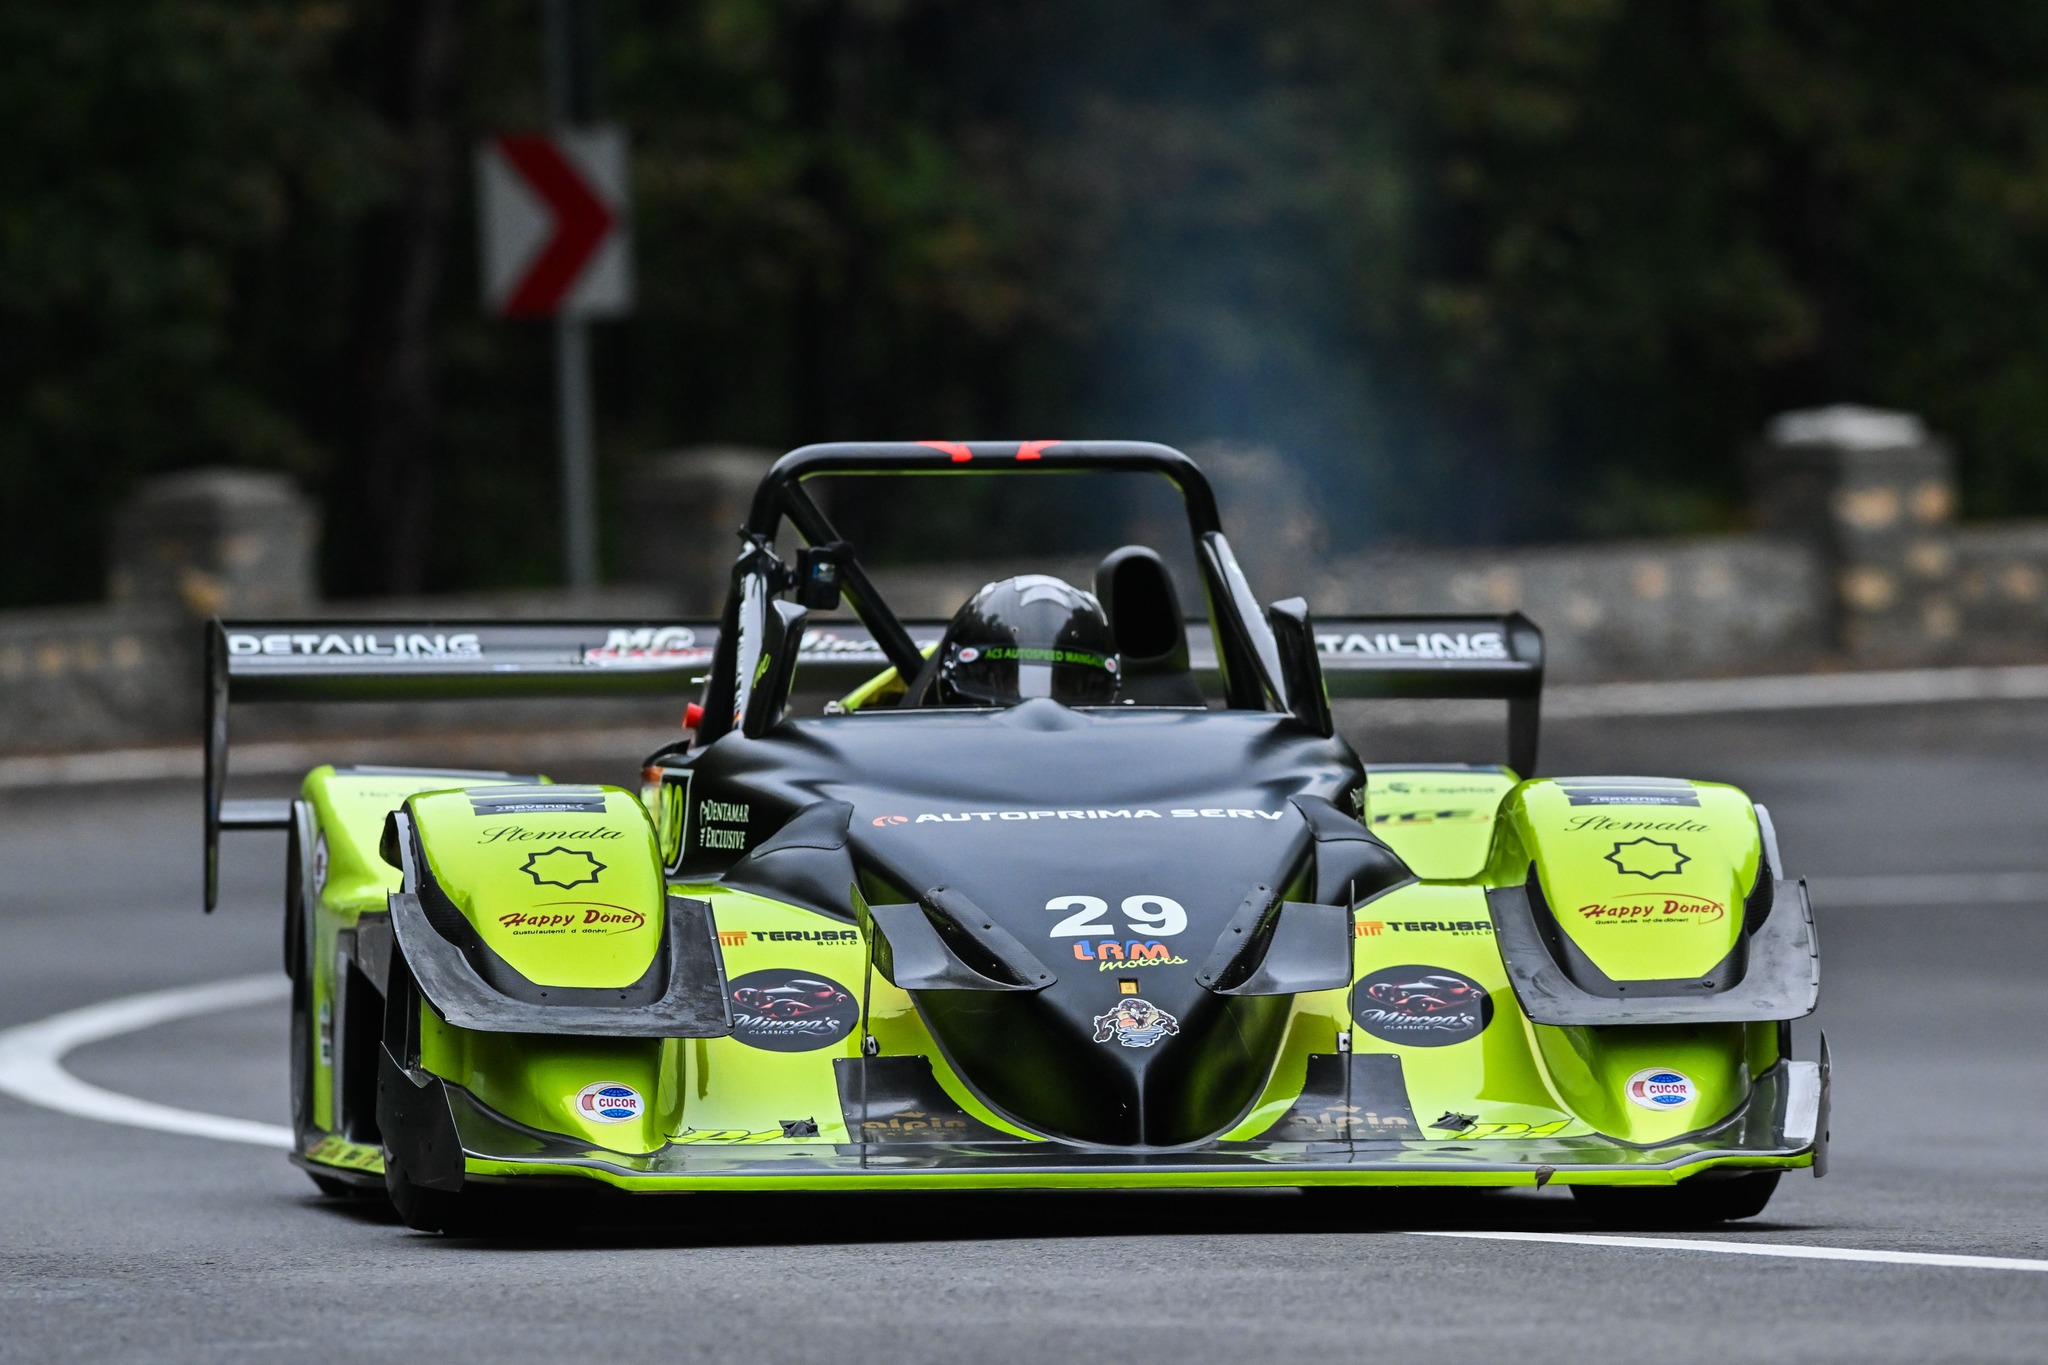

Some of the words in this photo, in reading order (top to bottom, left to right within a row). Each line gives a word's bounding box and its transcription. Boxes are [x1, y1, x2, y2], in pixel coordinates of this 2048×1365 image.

[228, 634, 482, 656] DETAILING
[1316, 632, 1503, 655] TAILING
[706, 799, 750, 823] DENTAMAR
[915, 808, 1163, 823] AUTOPRIMA
[1170, 808, 1284, 821] SERV
[1564, 814, 1712, 832] Stemata
[477, 825, 626, 844] Stemata
[705, 826, 746, 850] EXCLUSIVE
[498, 912, 575, 928] Happy
[1045, 894, 1188, 938] 29
[1578, 904, 1654, 918] Happy
[1073, 939, 1172, 962] LRM
[1099, 955, 1188, 972] motors
[1361, 1009, 1476, 1032] Mircea's
[1649, 1084, 1687, 1095] CUCOR
[598, 1098, 636, 1109] CUCOR
[1287, 1112, 1408, 1131] alpin
